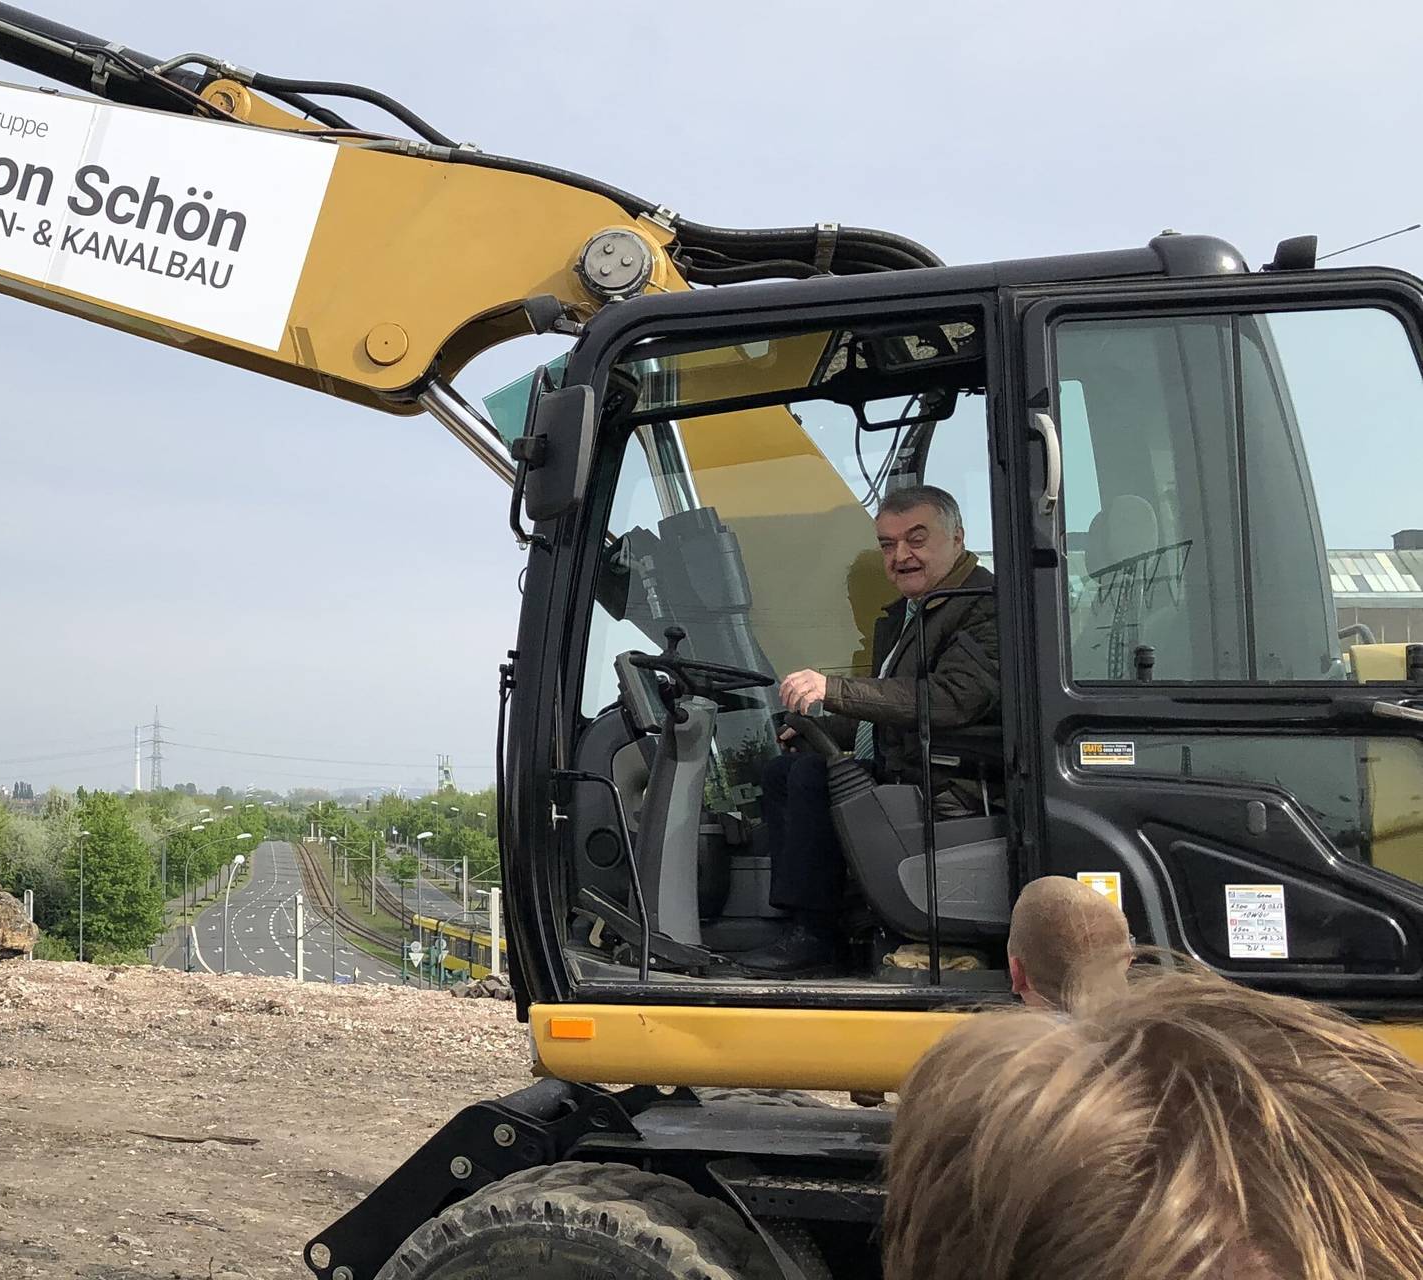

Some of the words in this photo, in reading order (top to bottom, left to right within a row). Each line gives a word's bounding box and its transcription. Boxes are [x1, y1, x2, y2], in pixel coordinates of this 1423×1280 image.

[67, 164, 247, 252] Schön
[32, 218, 53, 247] &
[60, 225, 234, 290] KANALBAU
